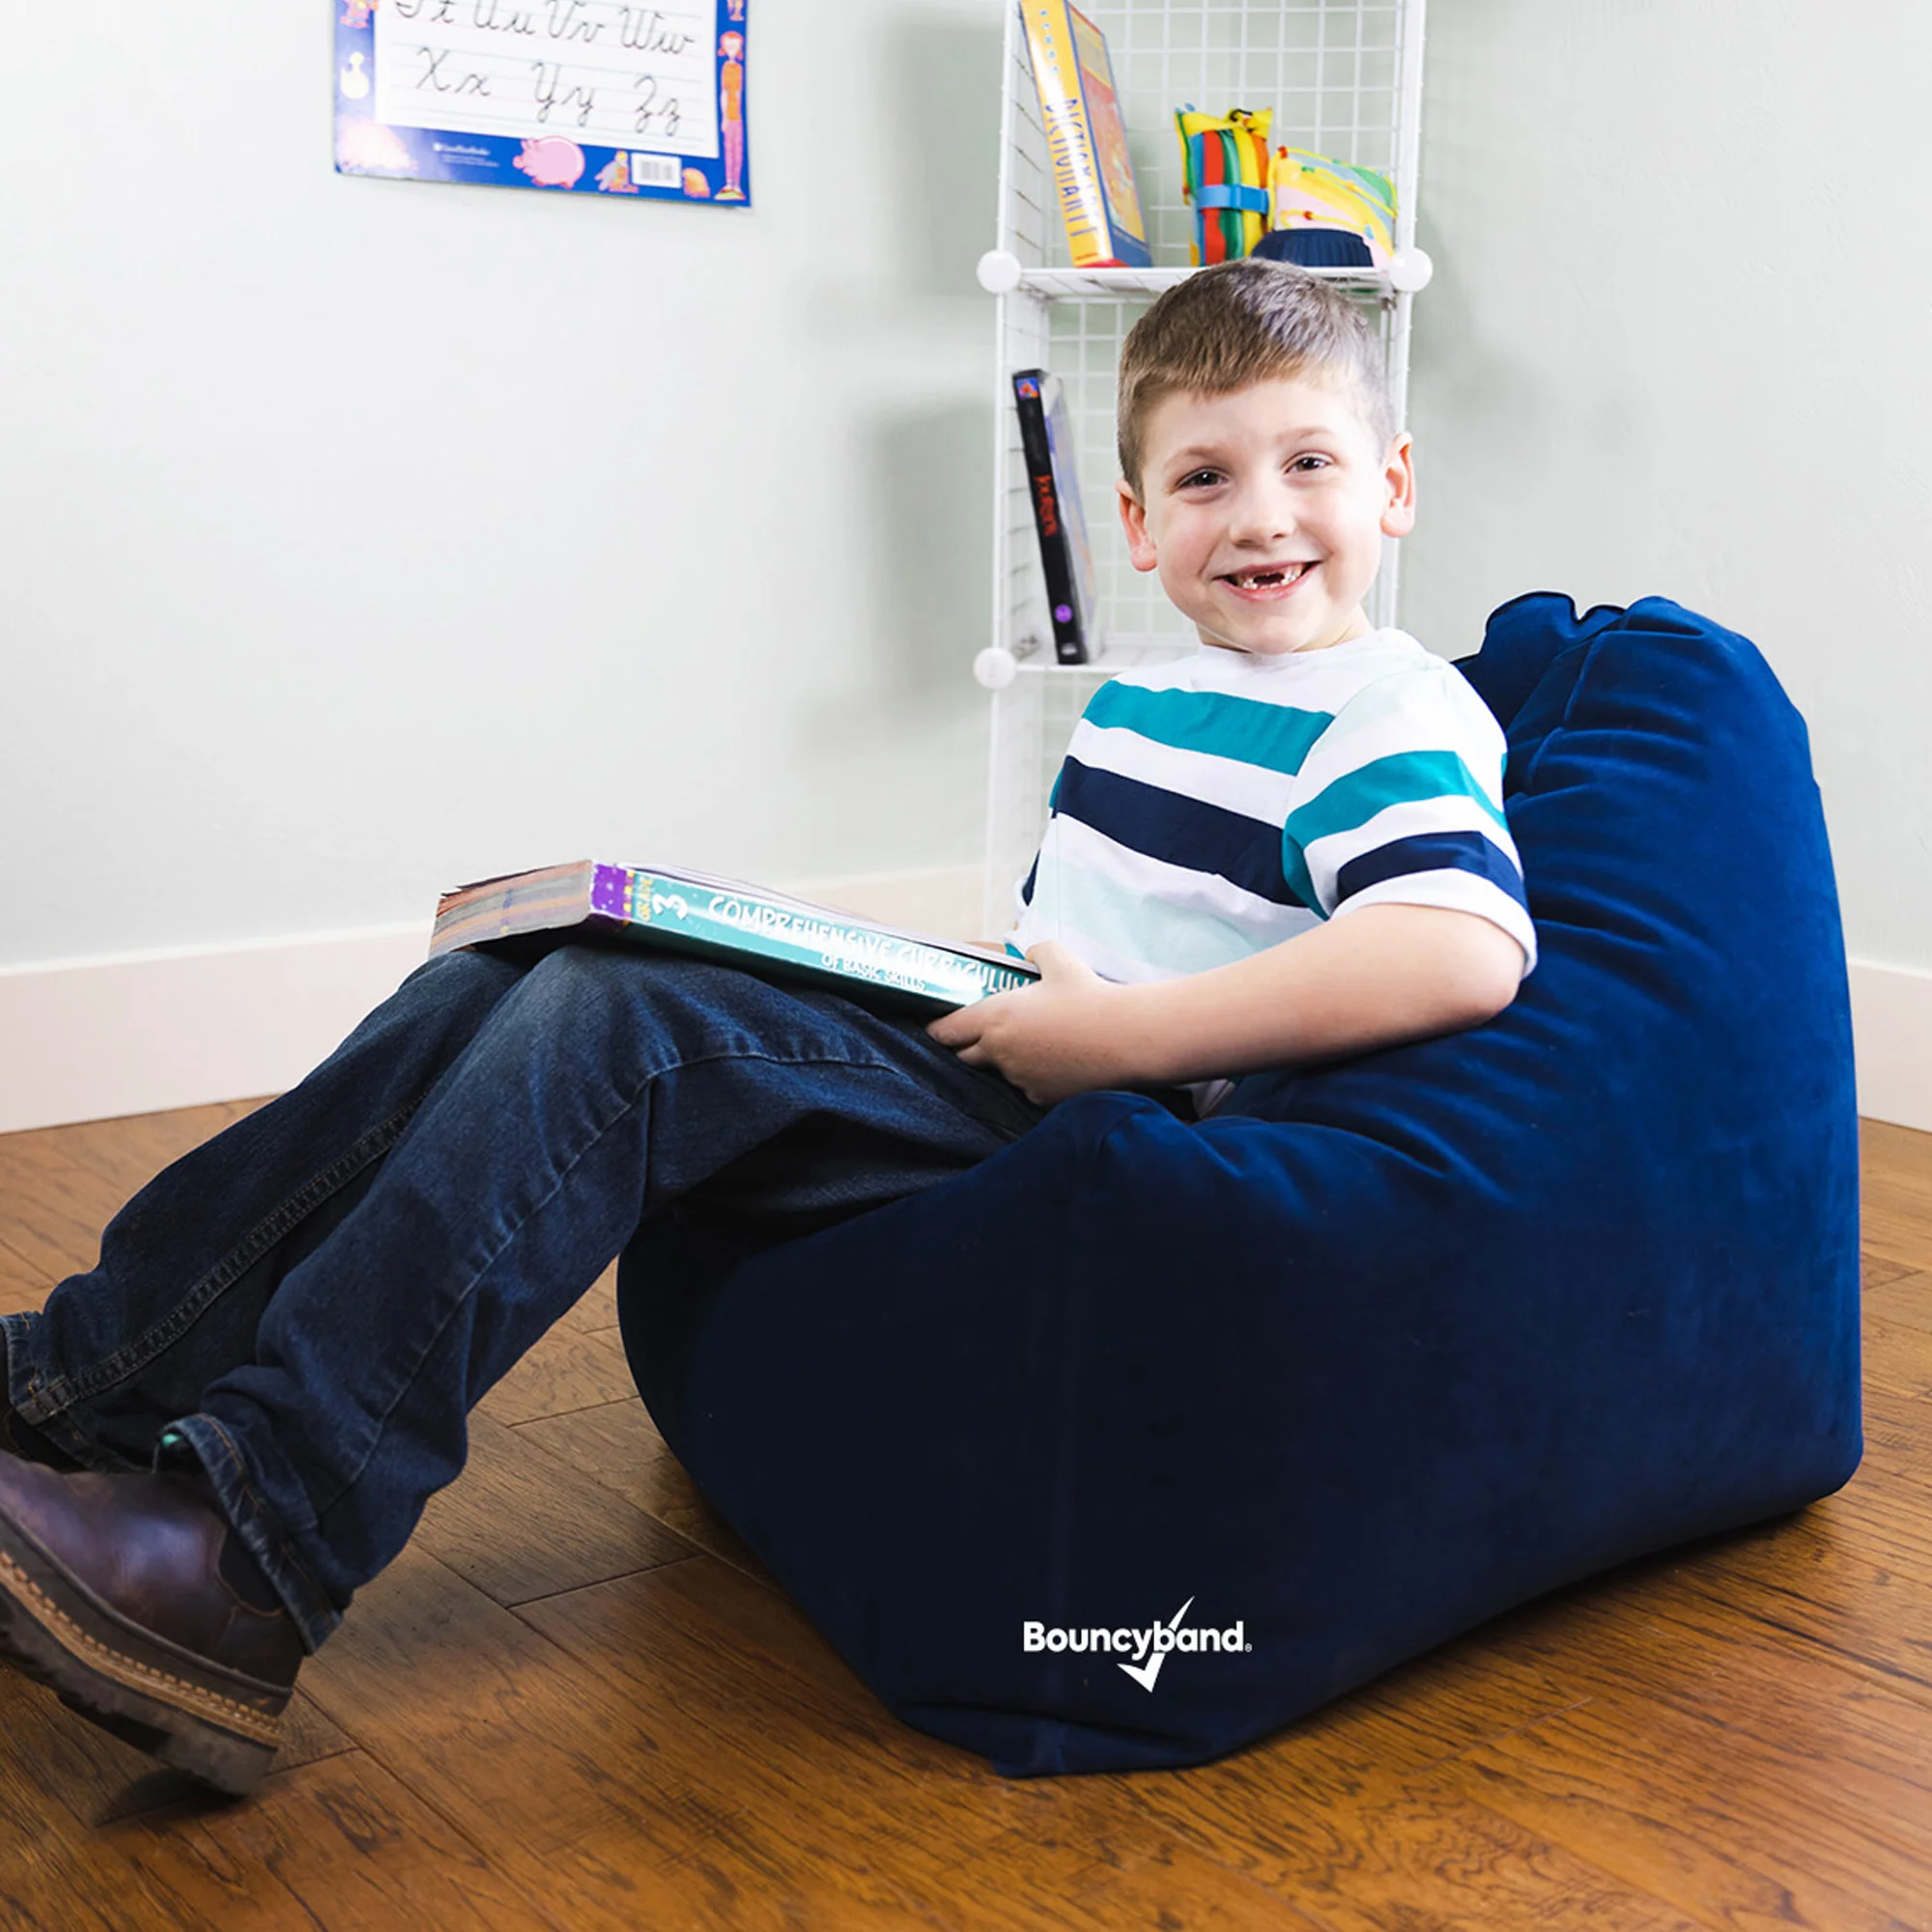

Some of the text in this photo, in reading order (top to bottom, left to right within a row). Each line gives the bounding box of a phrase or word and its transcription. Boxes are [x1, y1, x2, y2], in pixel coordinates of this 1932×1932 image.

[618, 7, 696, 54] Ww
[416, 46, 680, 136] Xx Yy Zz
[637, 875, 653, 923] GRADE
[652, 894, 689, 920] 3
[708, 895, 893, 959] COMPREHENSIVE
[821, 952, 926, 992] OF BASIC SKILLS
